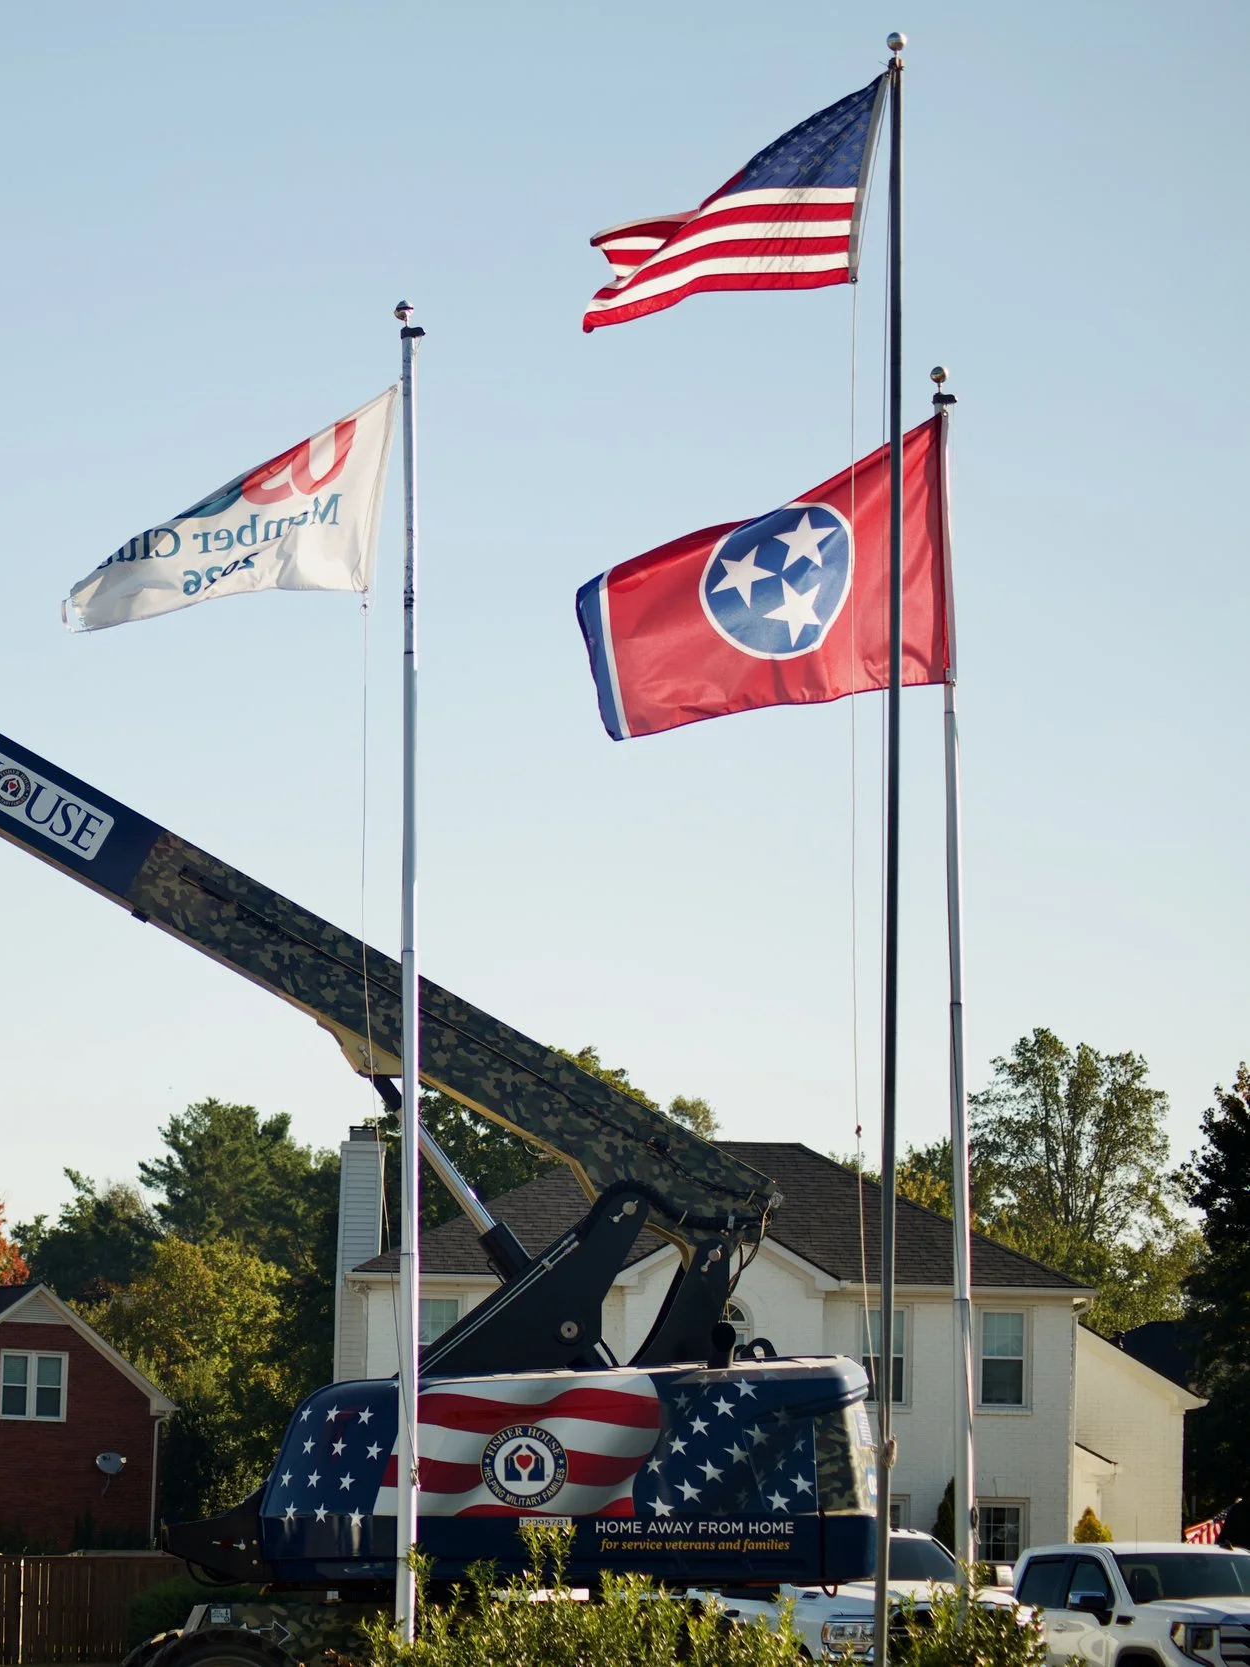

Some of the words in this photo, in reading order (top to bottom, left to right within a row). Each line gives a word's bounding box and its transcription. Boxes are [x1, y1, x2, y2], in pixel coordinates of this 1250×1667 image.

[486, 1427, 523, 1457] FISHER
[527, 1427, 563, 1457] HOUSE
[483, 1466, 506, 1498] HELPING
[505, 1494, 543, 1507] MILITARY
[542, 1468, 566, 1500] FAMILIES
[595, 1521, 642, 1534] HOME
[647, 1521, 693, 1534] AWAY
[698, 1521, 743, 1534] FROM
[748, 1521, 794, 1534] HOME
[600, 1538, 618, 1552] for
[621, 1538, 662, 1550] service
[665, 1539, 715, 1550] veterans
[718, 1538, 740, 1550] and
[743, 1538, 790, 1553] families
